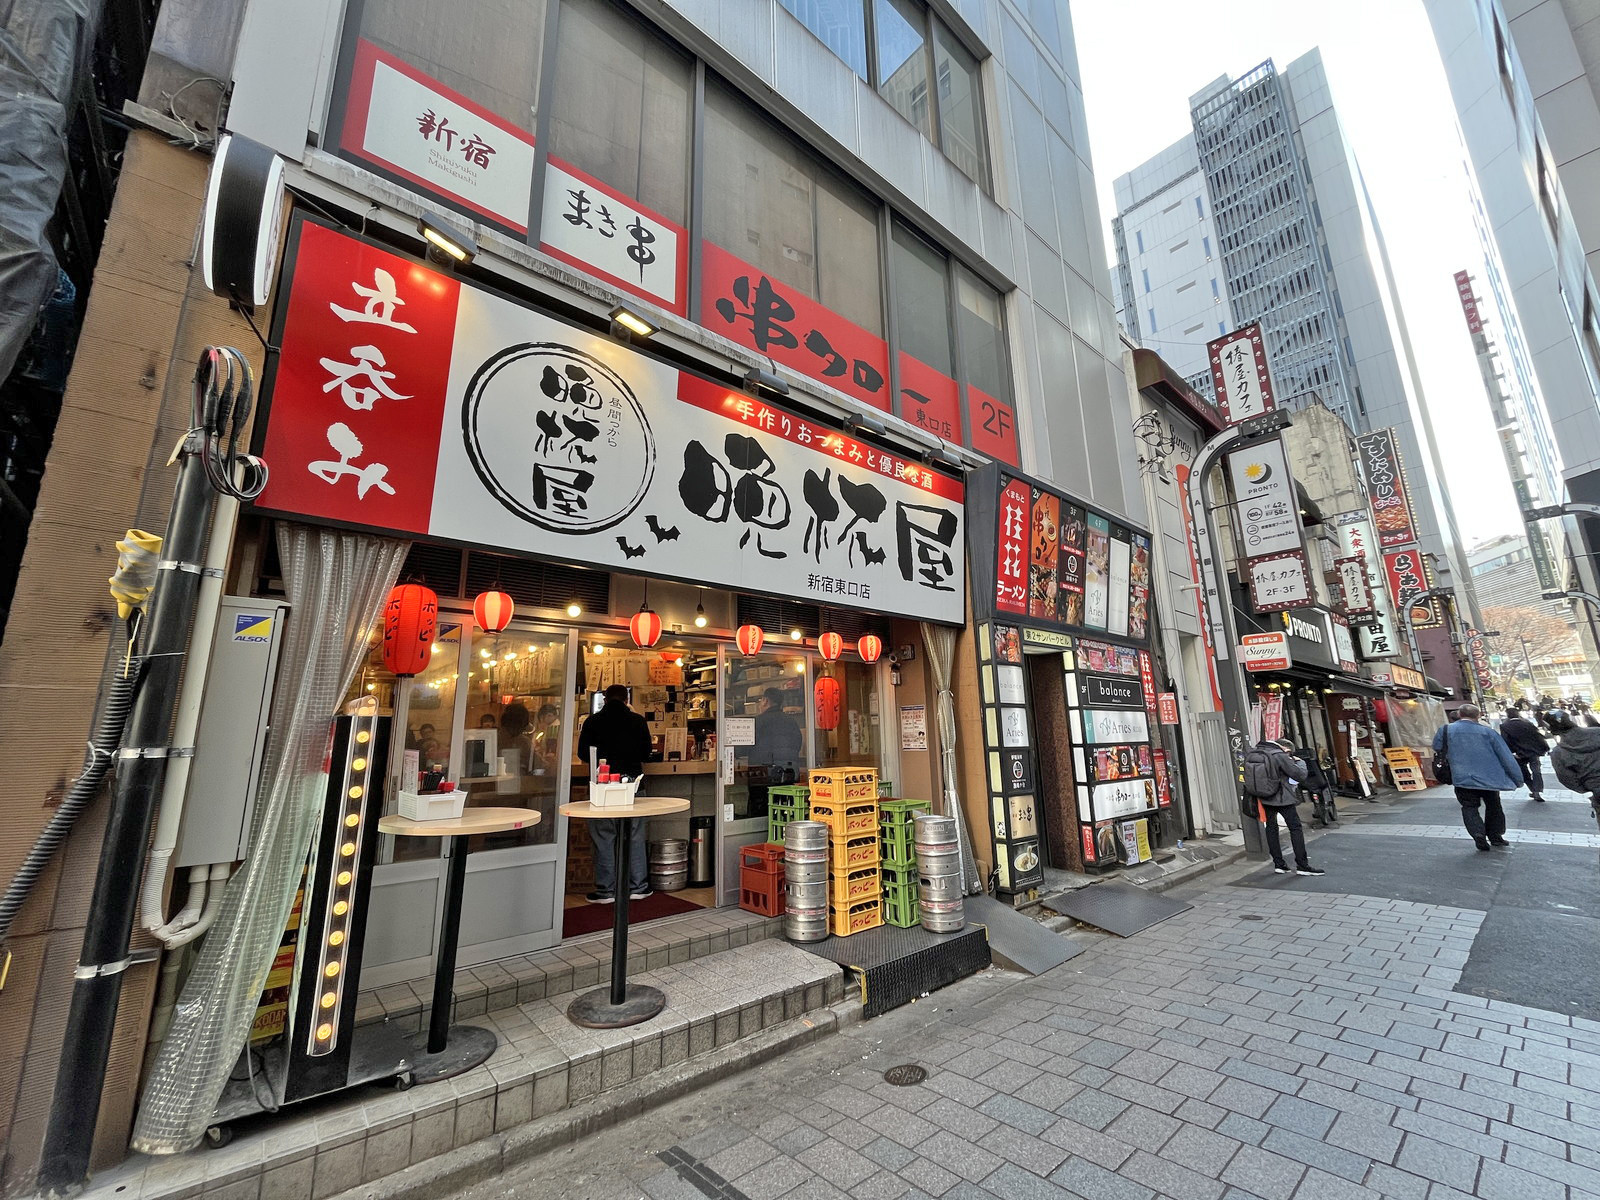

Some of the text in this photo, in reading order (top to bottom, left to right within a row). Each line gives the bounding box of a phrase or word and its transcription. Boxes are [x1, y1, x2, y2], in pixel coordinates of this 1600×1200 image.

[416, 108, 497, 170] 新宿
[428, 156, 478, 187] Makigushi
[561, 188, 656, 284] まき串
[307, 268, 418, 501] 立呑み
[915, 408, 952, 439] 東口店
[981, 400, 1011, 439] 2F
[533, 364, 603, 520] 晩杯屋
[736, 399, 934, 491] 手作りおつまみと優良な酒
[1005, 488, 1025, 504] くまもと
[1248, 483, 1279, 495] PRONTO
[678, 432, 958, 593] 晩杯屋
[1003, 502, 1024, 578] 桂花
[807, 572, 871, 600] 新宿東口店
[997, 580, 1026, 600] ラーメン
[234, 635, 268, 643] ALSOK
[385, 599, 401, 658] ホッピー
[419, 602, 435, 659] ホッピー
[1292, 616, 1322, 644] PRONTO
[1370, 610, 1391, 653] 田屋
[1246, 646, 1277, 658] Sunny
[1100, 680, 1131, 698] balance
[1006, 728, 1024, 737] Aries
[1112, 721, 1132, 734] Aries
[846, 786, 871, 798] ホッピー
[848, 817, 873, 829] ホッピー
[849, 849, 874, 862] ホッピー
[850, 881, 875, 894] ホッピー
[851, 913, 877, 928] ホッピー
